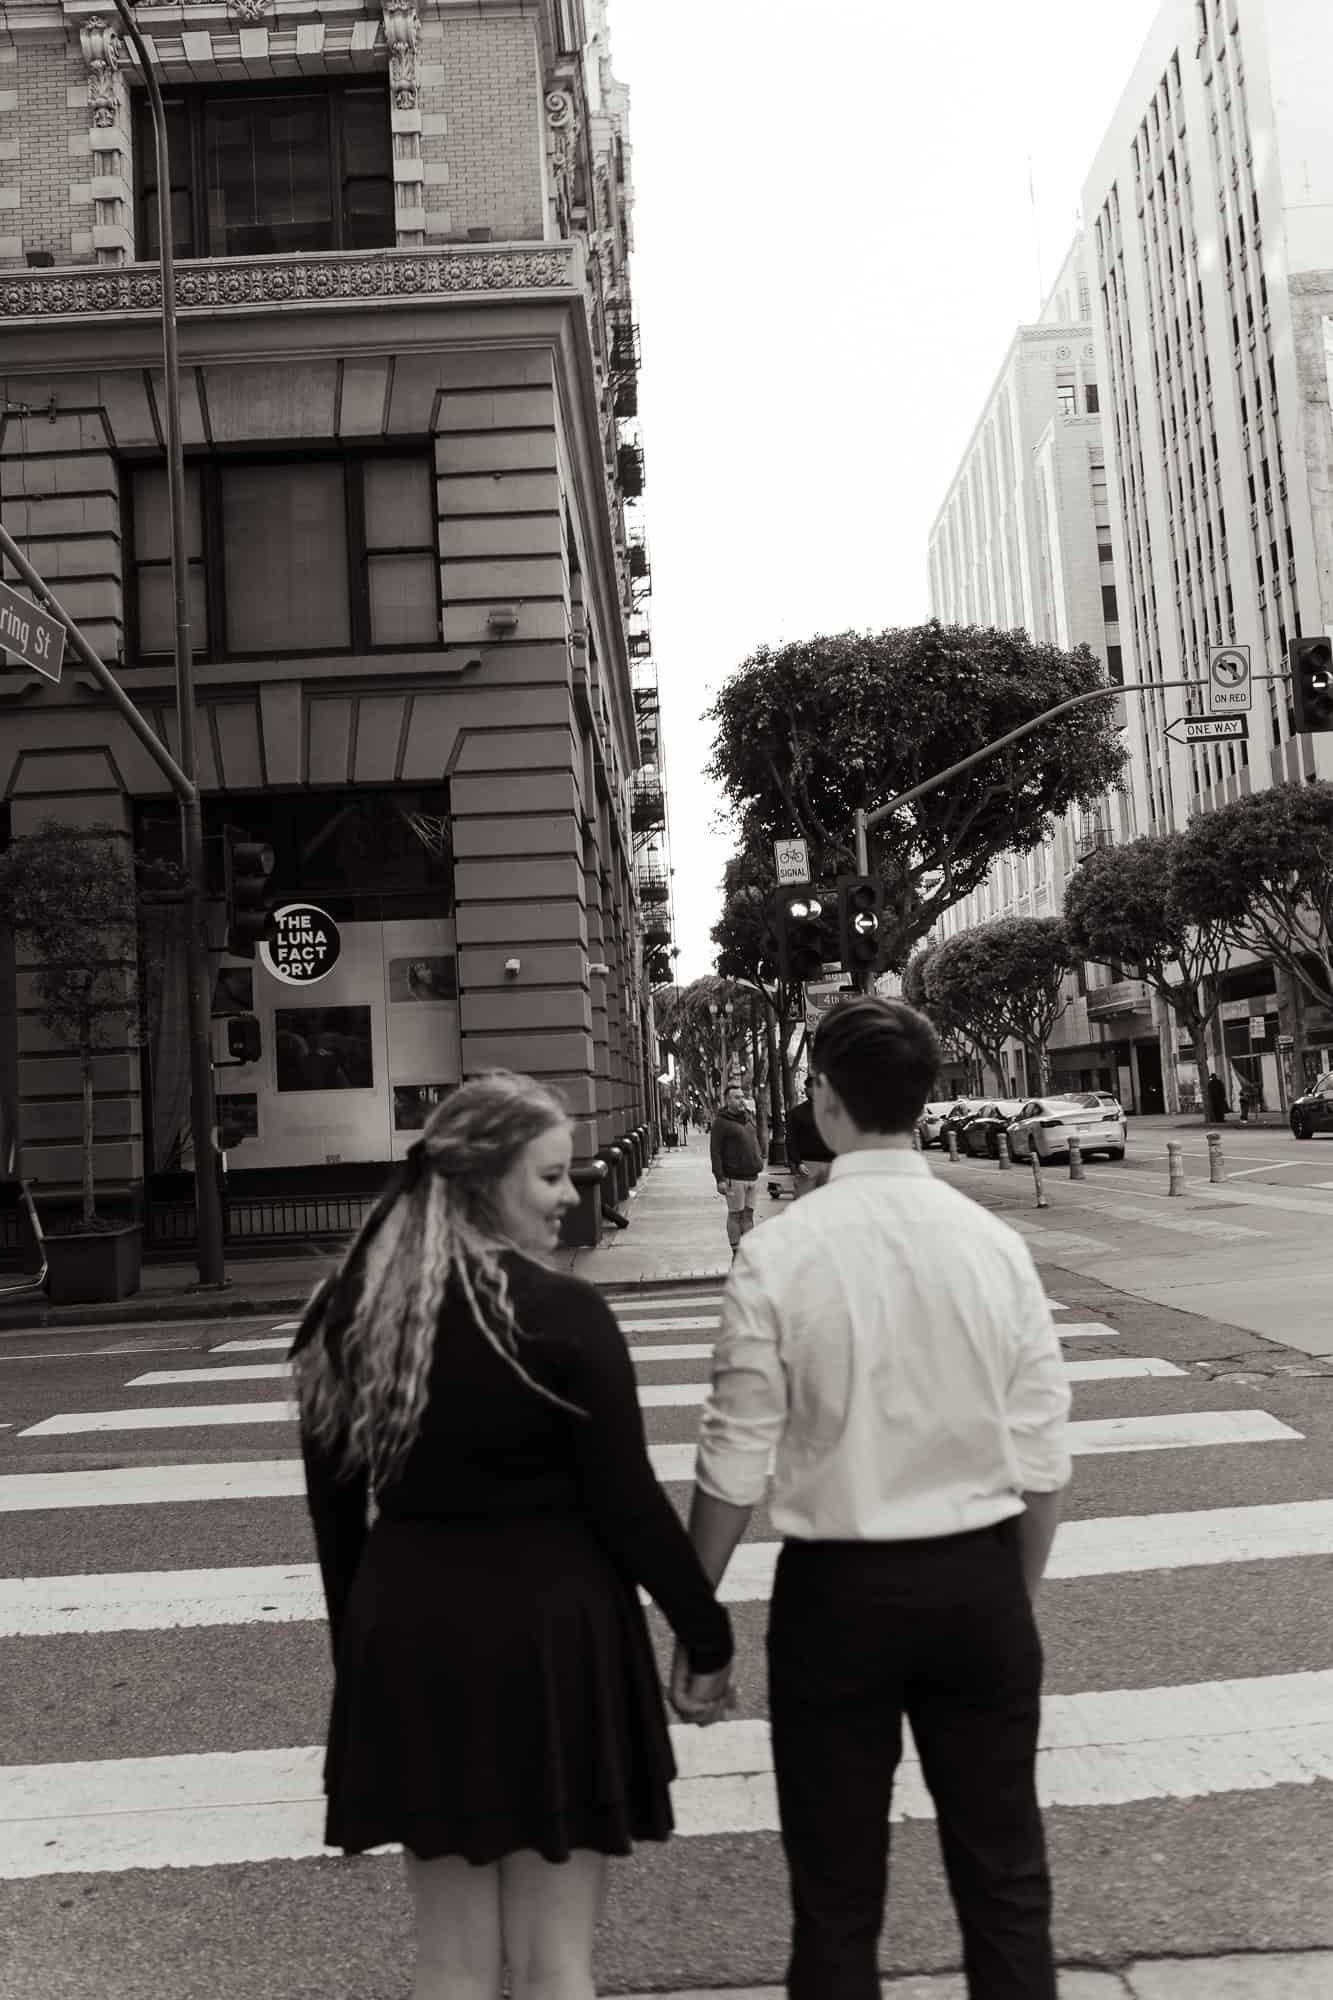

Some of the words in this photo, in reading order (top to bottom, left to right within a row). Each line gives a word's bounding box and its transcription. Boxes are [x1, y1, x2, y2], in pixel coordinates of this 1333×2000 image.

[34, 625, 52, 659] St
[1214, 694, 1227, 704] ON
[1229, 693, 1247, 703] RED
[1187, 724, 1212, 736] ONE
[1214, 722, 1239, 733] WAY
[780, 867, 806, 878] SIGNAL
[279, 915, 312, 930] THE
[277, 930, 327, 946] LUNA
[278, 946, 327, 961] FACT
[279, 961, 316, 977] ORY
